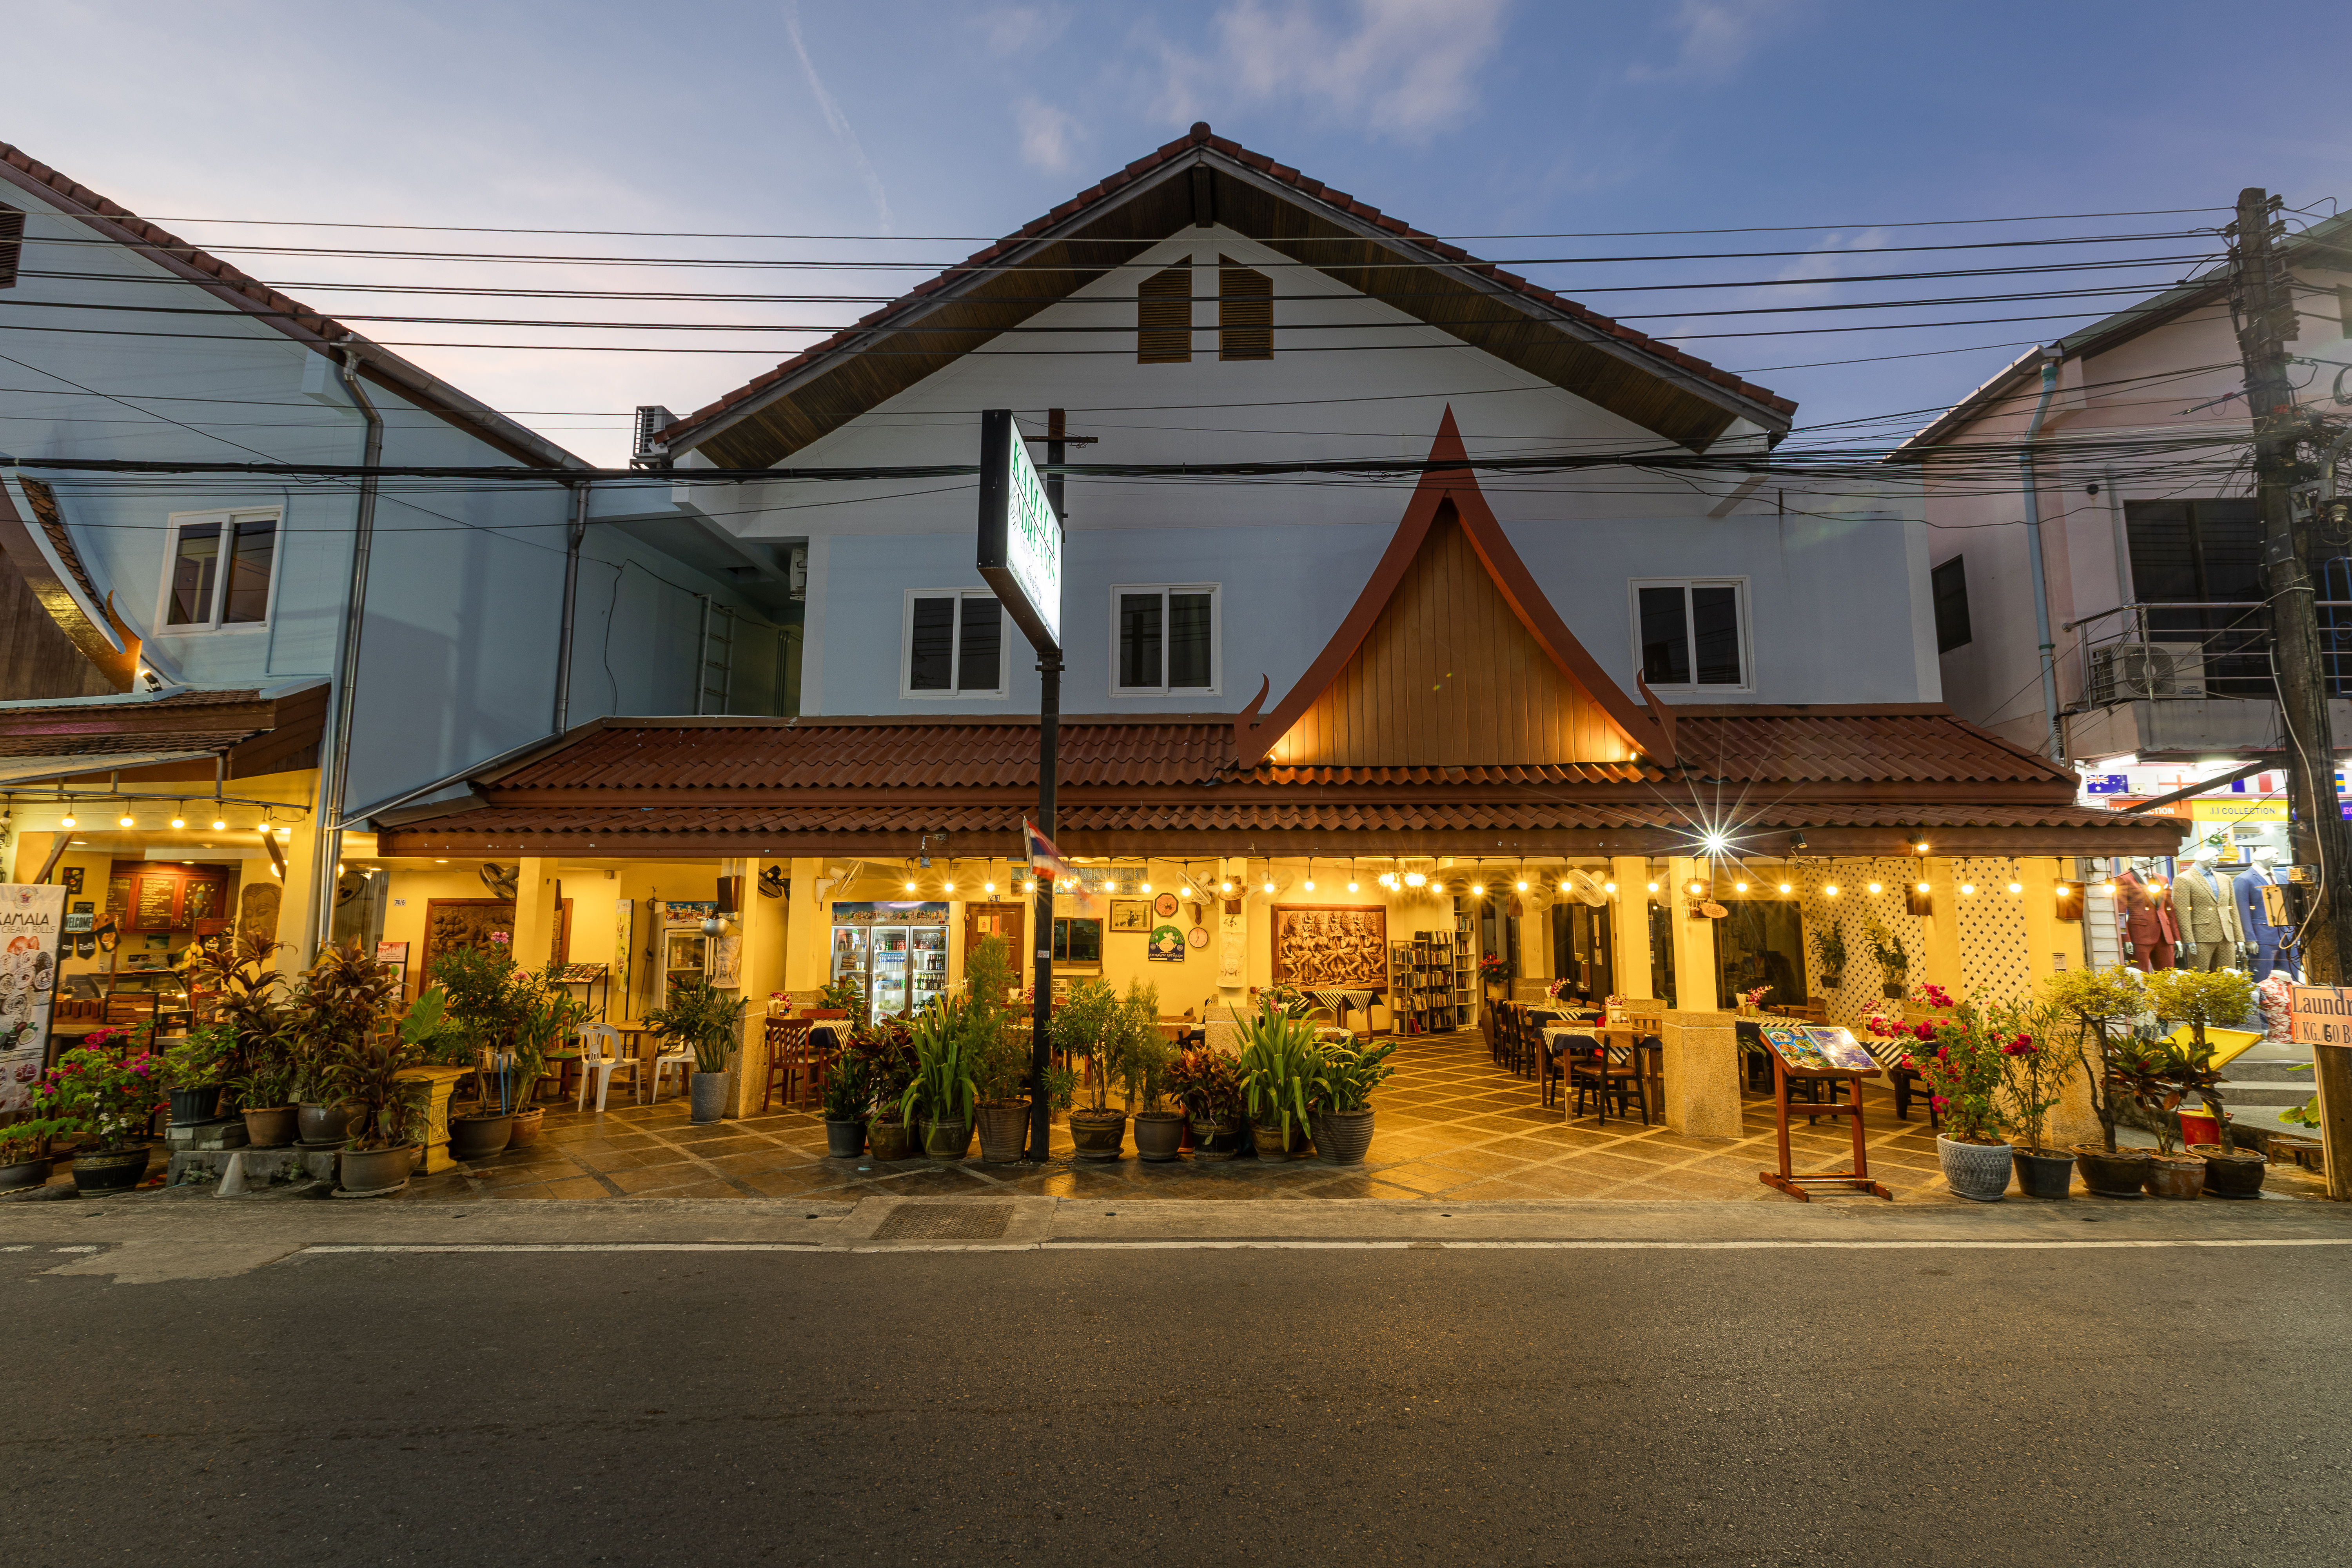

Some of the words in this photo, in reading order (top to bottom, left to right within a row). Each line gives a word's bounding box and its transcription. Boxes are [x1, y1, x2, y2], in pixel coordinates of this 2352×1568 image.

[1013, 438, 1054, 556] KAMALA
[1021, 499, 1055, 586] DREAMS
[2342, 1024, 2352, 1043] B
